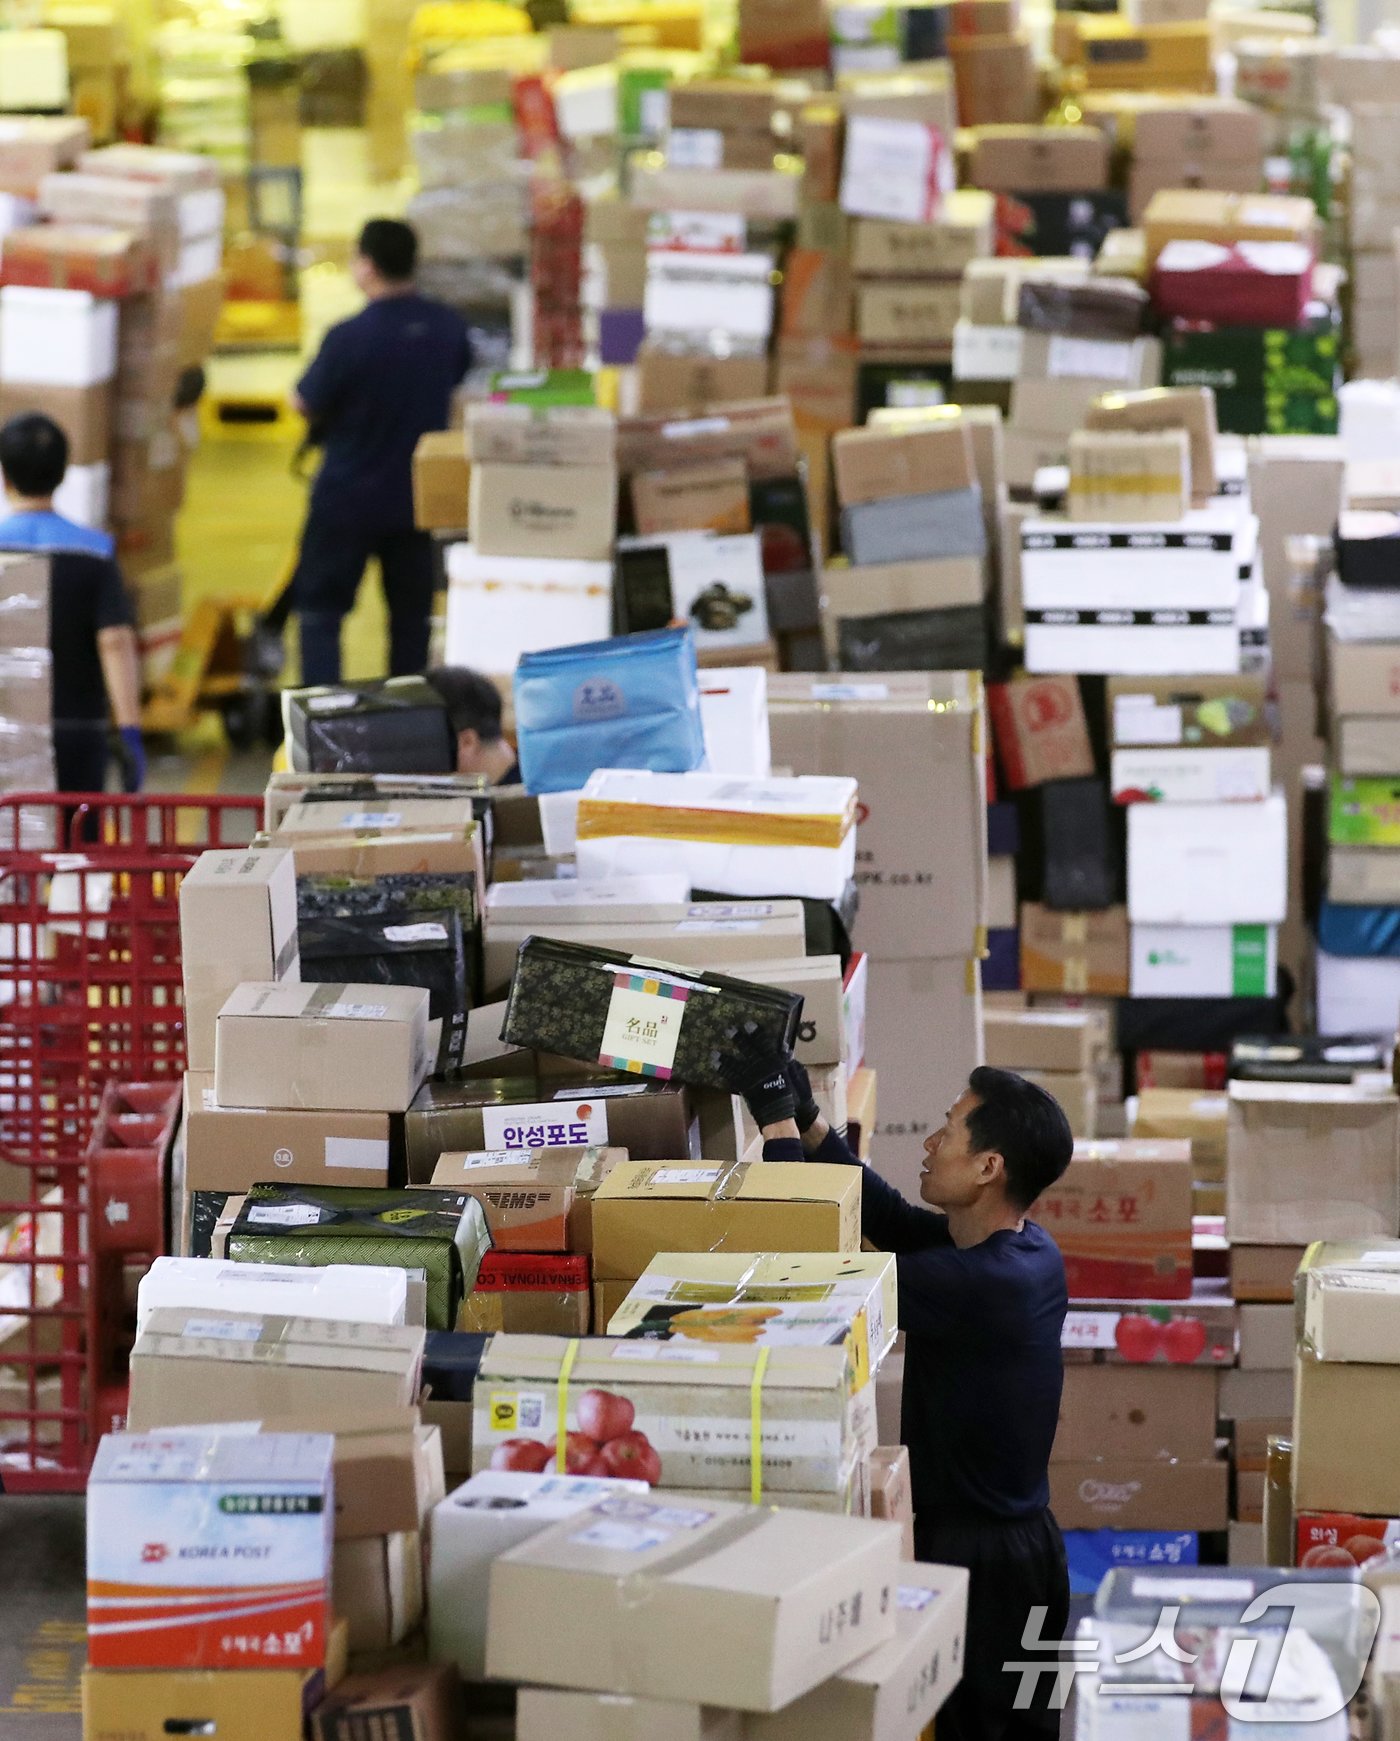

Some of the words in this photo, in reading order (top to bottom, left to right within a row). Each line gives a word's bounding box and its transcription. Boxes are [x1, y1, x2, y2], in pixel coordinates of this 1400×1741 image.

[625, 1017, 658, 1038] 名品
[621, 1033, 640, 1043] GIFT
[642, 1038, 657, 1046] SET
[503, 1123, 588, 1149] 안성포도
[499, 1192, 537, 1209] EMS
[179, 1545, 229, 1558] KOREA
[233, 1545, 271, 1559] POST
